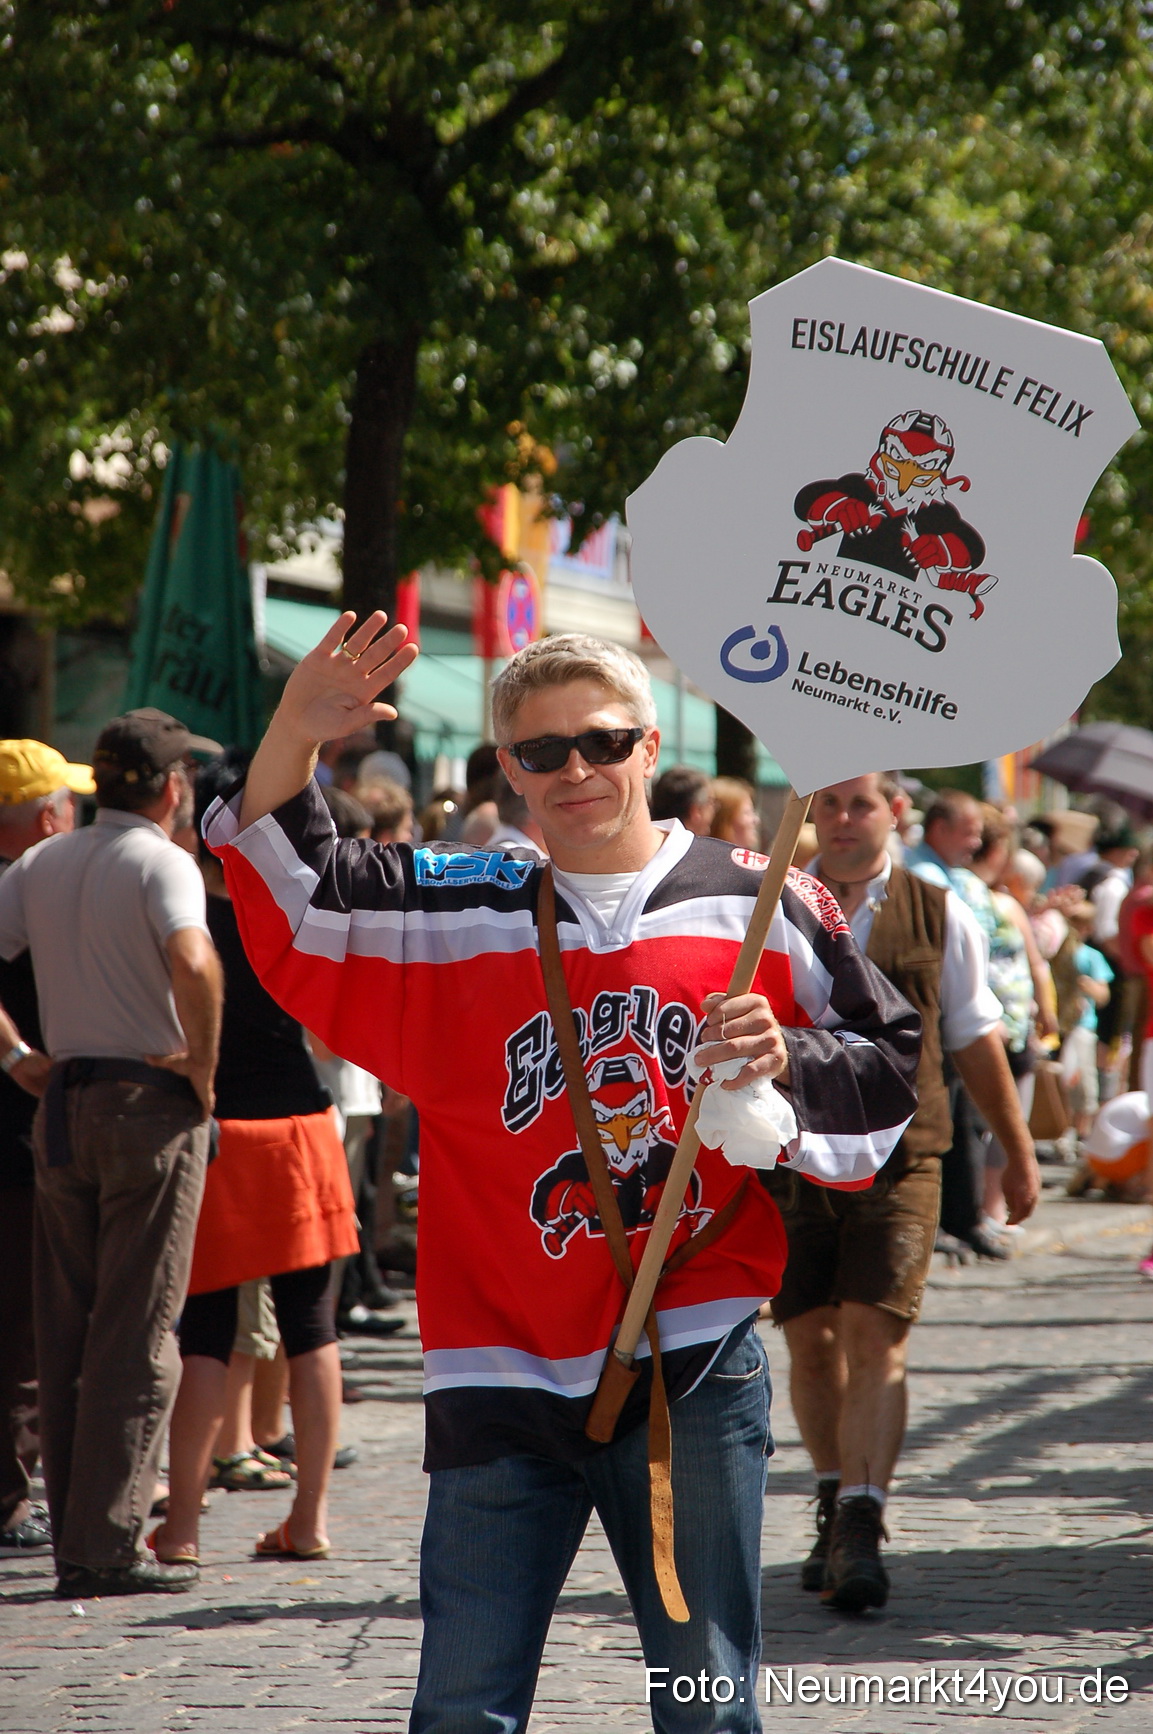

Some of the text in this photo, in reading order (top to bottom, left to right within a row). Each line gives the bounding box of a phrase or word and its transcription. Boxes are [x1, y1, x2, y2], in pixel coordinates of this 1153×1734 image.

[791, 318, 1095, 438] EISLAUFSCHULE FELIX
[766, 560, 954, 653] EAGLES
[816, 563, 922, 603] NEUMARKT
[791, 678, 902, 724] Neumarkt e.V.
[797, 651, 959, 720] Lebenshilfe
[501, 985, 707, 1134] Eagle
